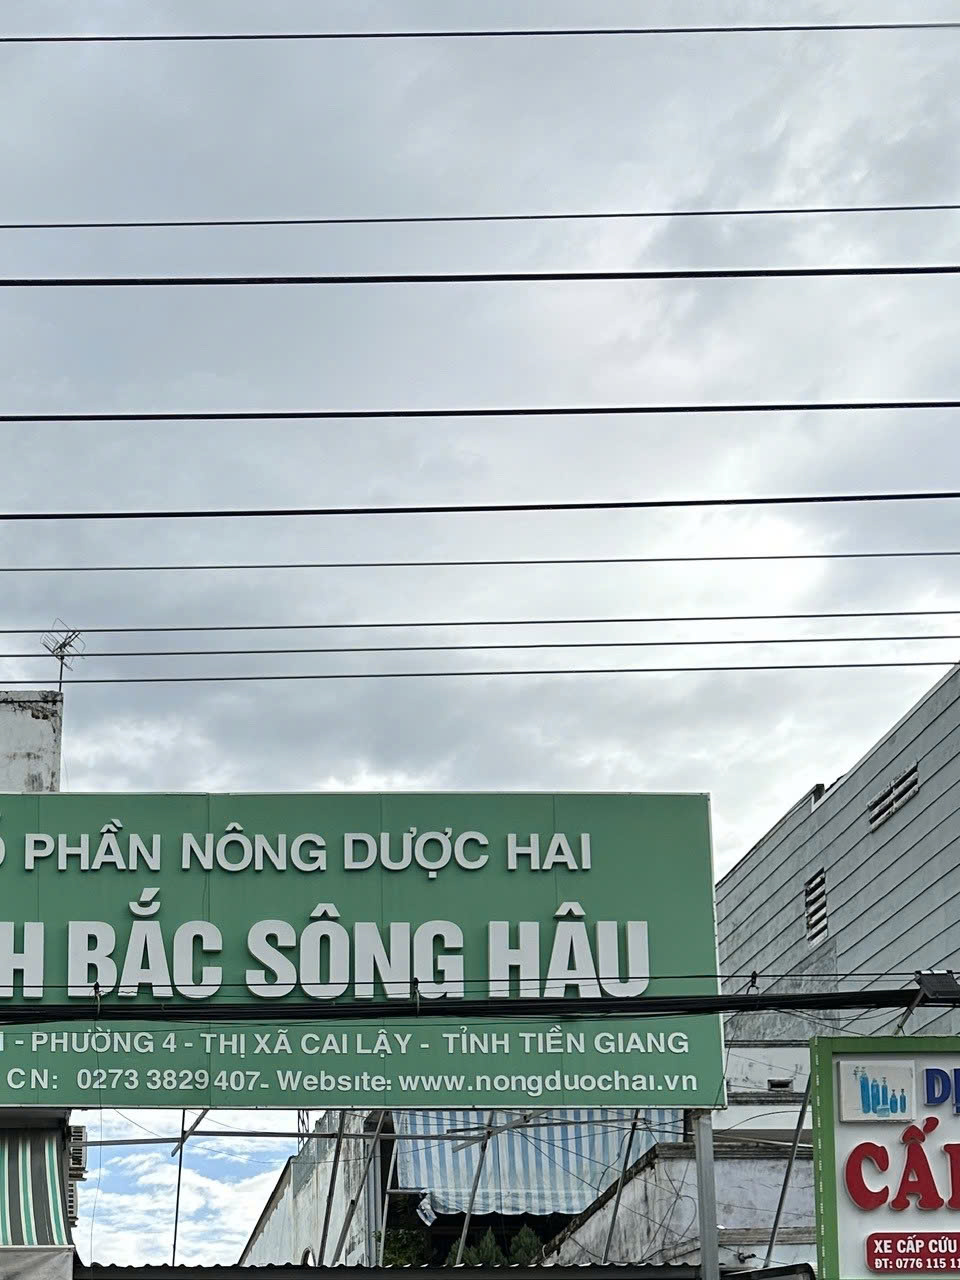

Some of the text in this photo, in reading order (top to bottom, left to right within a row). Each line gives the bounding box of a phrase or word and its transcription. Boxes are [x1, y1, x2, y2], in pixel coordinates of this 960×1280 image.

[24, 819, 161, 871] PHẦN
[181, 822, 327, 872] NÔNG
[344, 827, 489, 878] DƯỢC
[507, 832, 592, 870] HAI
[67, 888, 223, 999] BẮC
[245, 903, 464, 999] SÔNG
[31, 1027, 154, 1053] PHƯỜNG
[162, 1032, 177, 1053] 4
[200, 1033, 246, 1058] THỊ
[253, 1029, 292, 1054] XÃ
[300, 1033, 348, 1054] CAI
[356, 1029, 412, 1058] LẬY
[442, 1025, 510, 1054] TỈNH
[519, 1025, 585, 1053] TIỀN
[594, 1032, 689, 1053] GIANG
[7, 1068, 58, 1089] CN:
[77, 1068, 139, 1090] 0273
[874, 1234, 957, 1253] XE CẤP CỨU
[874, 1258, 893, 1268] ĐT:
[895, 1258, 923, 1269] 0776
[926, 1258, 947, 1268] 115
